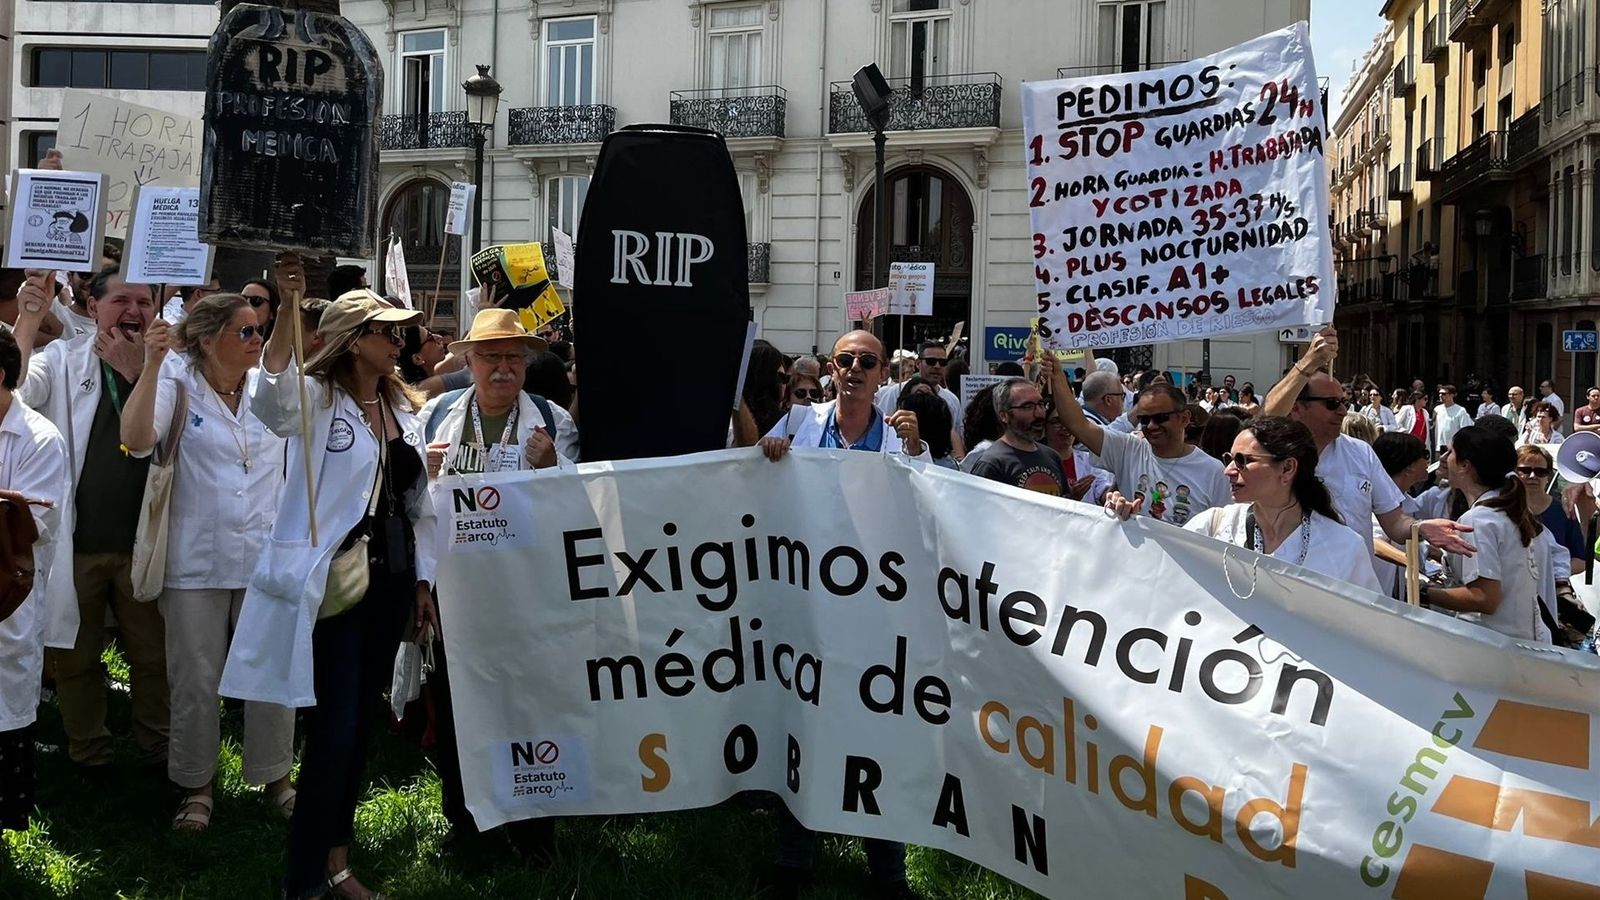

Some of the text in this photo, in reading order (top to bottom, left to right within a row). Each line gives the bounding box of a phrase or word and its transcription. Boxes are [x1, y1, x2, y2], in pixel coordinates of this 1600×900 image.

[259, 46, 331, 87] RIP
[1057, 64, 1237, 121] PEDIMOS:
[71, 102, 195, 149] 1 HORA
[1058, 121, 1145, 161] STOP
[1155, 102, 1257, 149] GUARDIAS
[94, 133, 203, 177] TRABAJA
[188, 198, 199, 208] 13
[1054, 175, 1109, 201] HORA
[1062, 216, 1183, 252] JORNADA
[1191, 194, 1264, 237] 35-37
[1066, 251, 1127, 279] PLUS
[1141, 217, 1308, 266] NOCTURNIDAD
[610, 229, 715, 287] RIP
[1166, 262, 1230, 291] A1+
[1067, 290, 1230, 333] DESCANSOS
[1237, 276, 1320, 309] LEGALES
[1177, 316, 1203, 336] DE
[456, 518, 508, 531] Estatuto
[562, 513, 1335, 727] Exigimos atención
[586, 617, 1309, 869] médica de calidad
[514, 771, 566, 784] Estatuto
[1359, 691, 1477, 888] cesmcv
